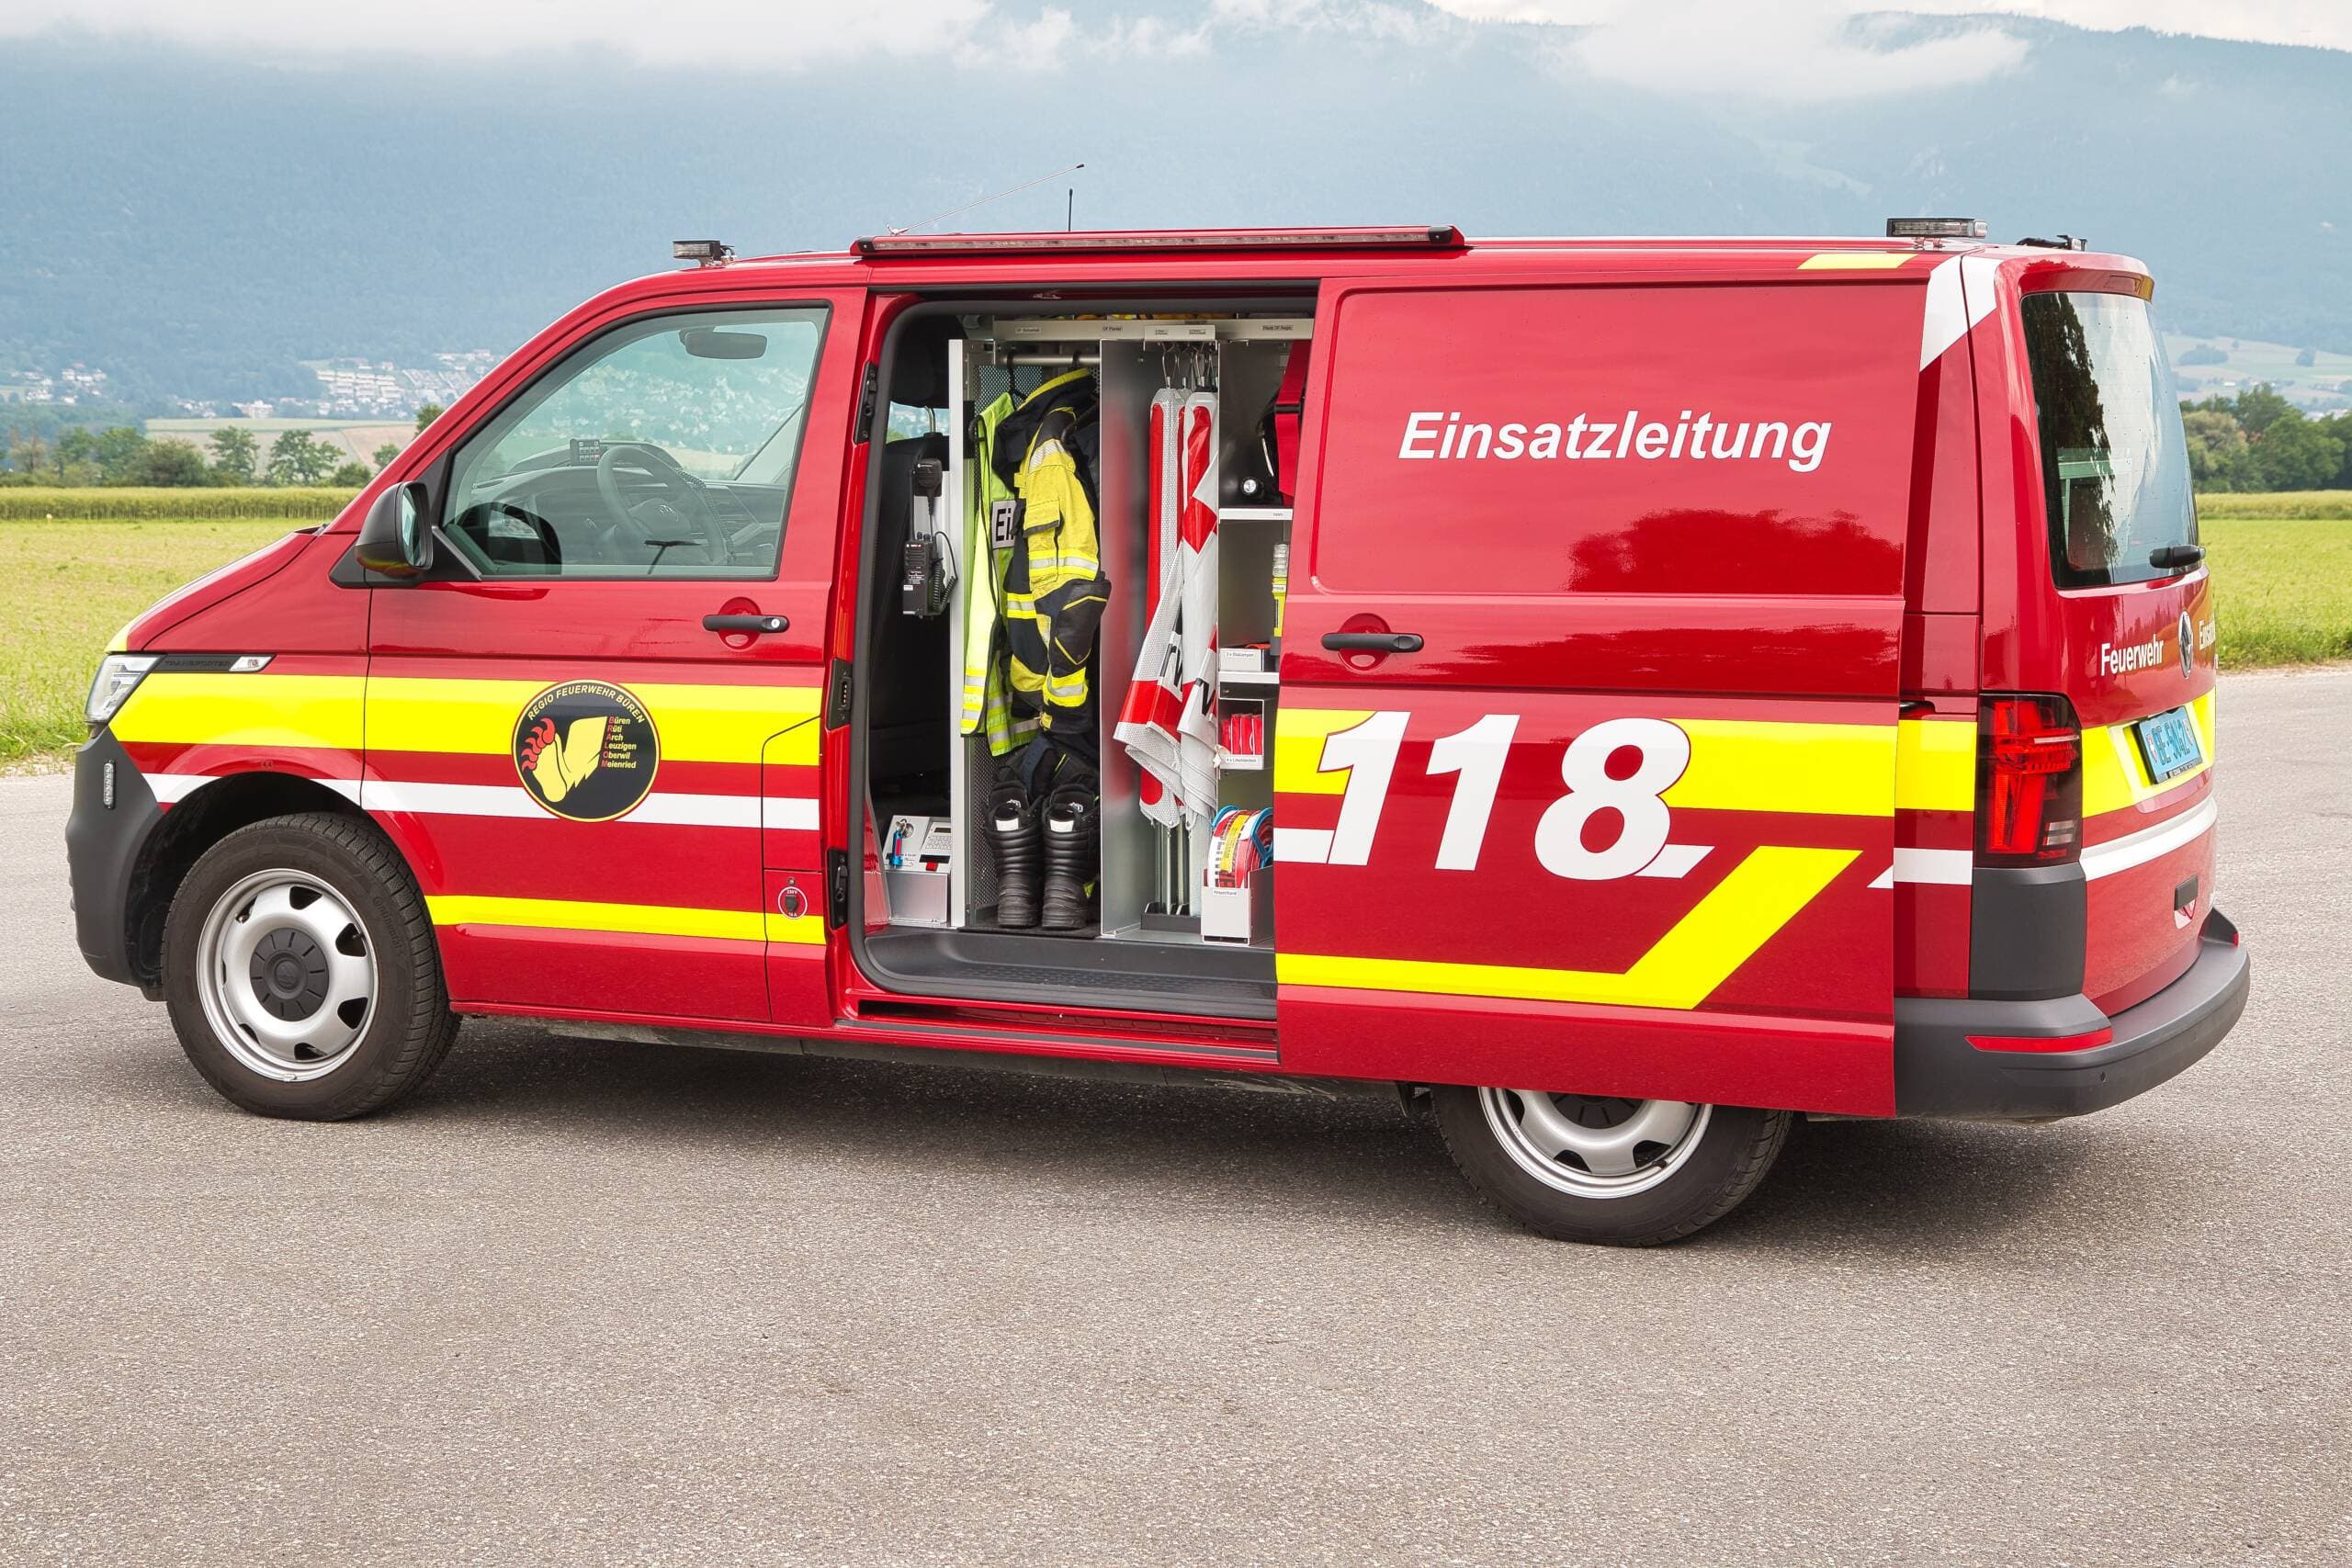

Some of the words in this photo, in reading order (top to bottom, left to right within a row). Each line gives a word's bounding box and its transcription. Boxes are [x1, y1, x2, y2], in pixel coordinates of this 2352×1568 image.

[1397, 410, 1832, 473] Einsatzleitung
[996, 508, 1014, 541] Ei
[2101, 634, 2165, 676] Feuerwehr
[527, 694, 554, 721] REGIO
[556, 684, 616, 699] FEUERWEHR
[616, 695, 645, 724] BÜREN
[608, 716, 631, 725] Büren
[604, 742, 637, 752] Leuzigen
[605, 733, 624, 741] Arch
[601, 761, 637, 770] Meienried
[603, 751, 631, 760] Oberwil
[1317, 710, 1691, 881] 118
